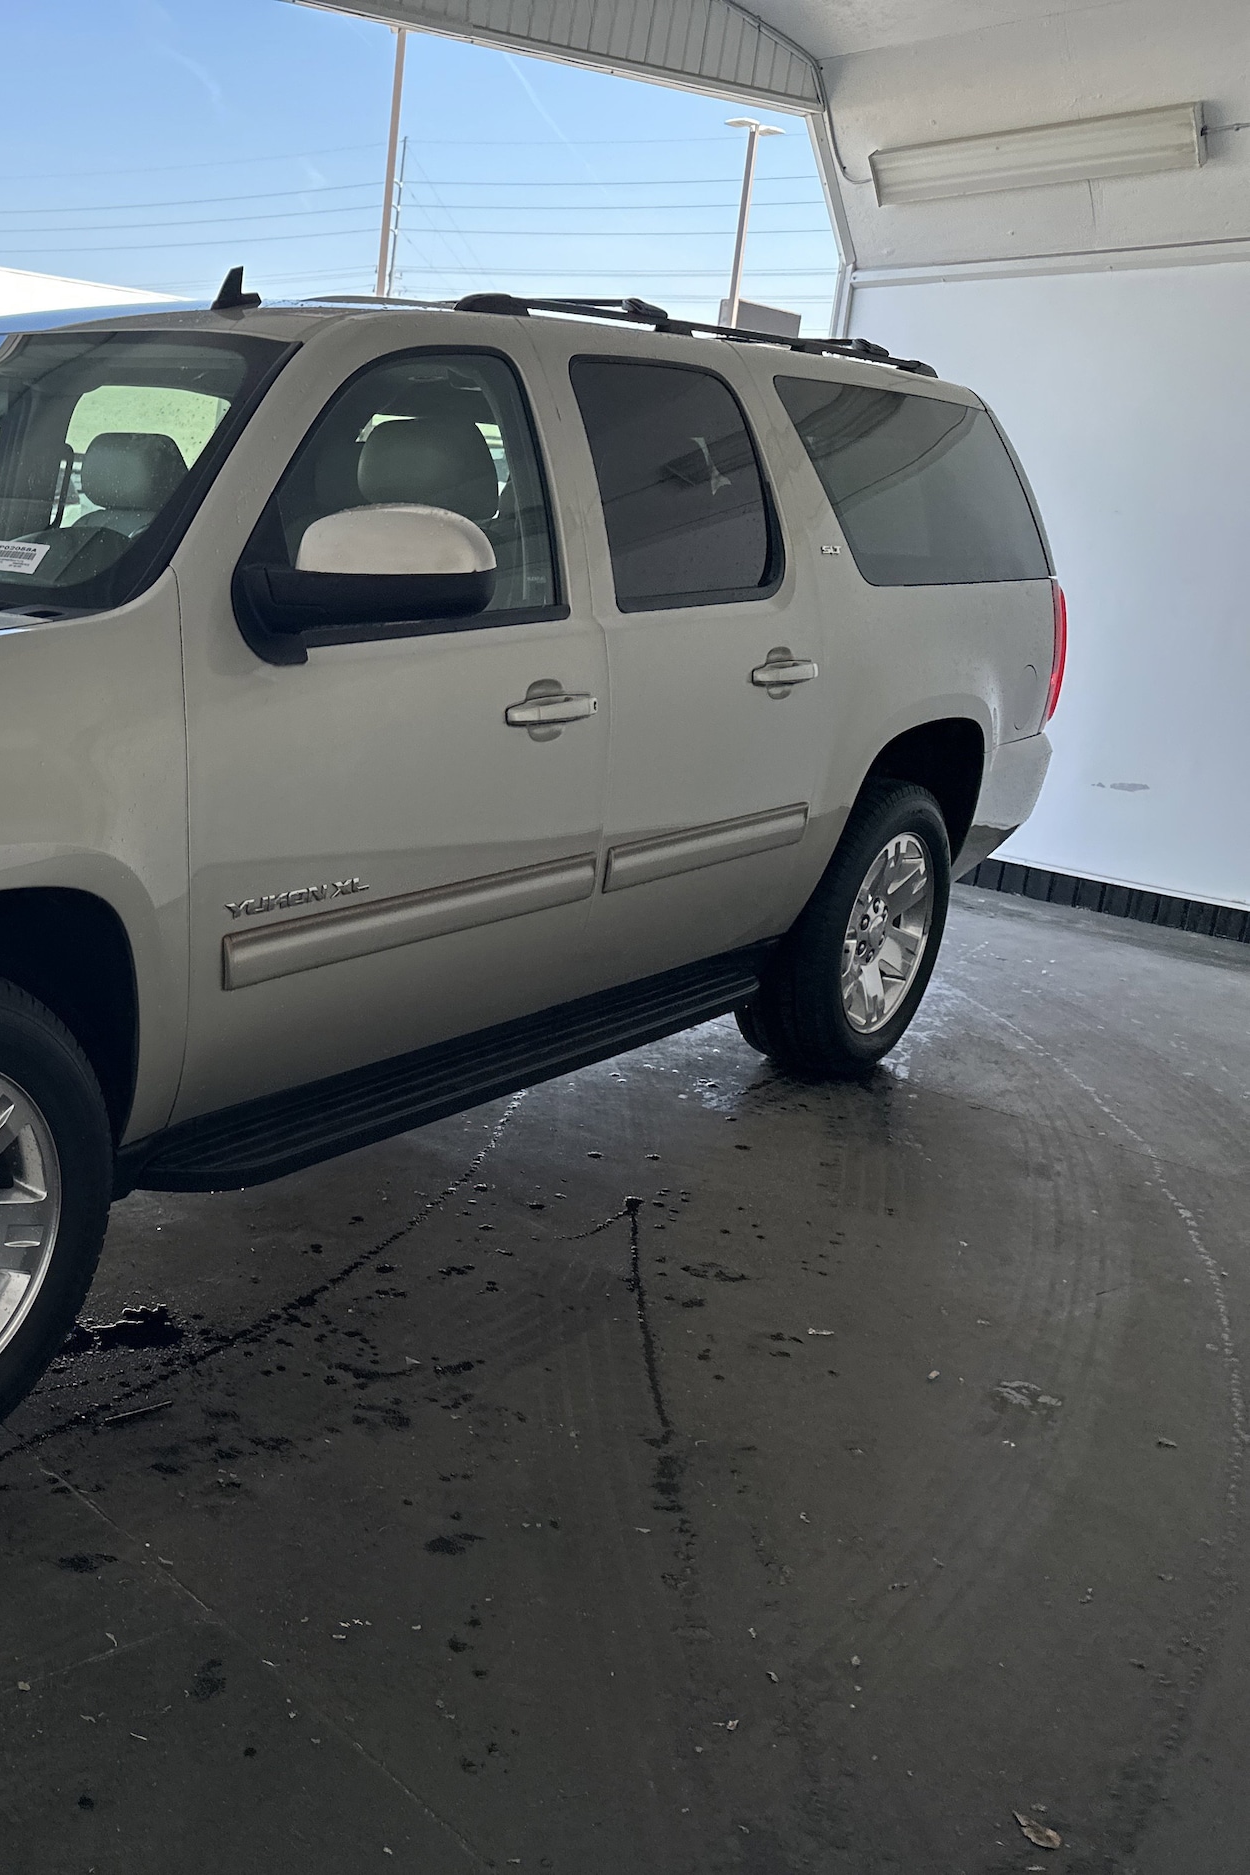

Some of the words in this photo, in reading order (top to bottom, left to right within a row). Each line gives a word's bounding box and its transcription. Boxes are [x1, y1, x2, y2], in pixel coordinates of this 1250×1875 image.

[820, 545, 841, 556] SLT
[224, 884, 328, 919] YUKON
[330, 877, 370, 899] XL
